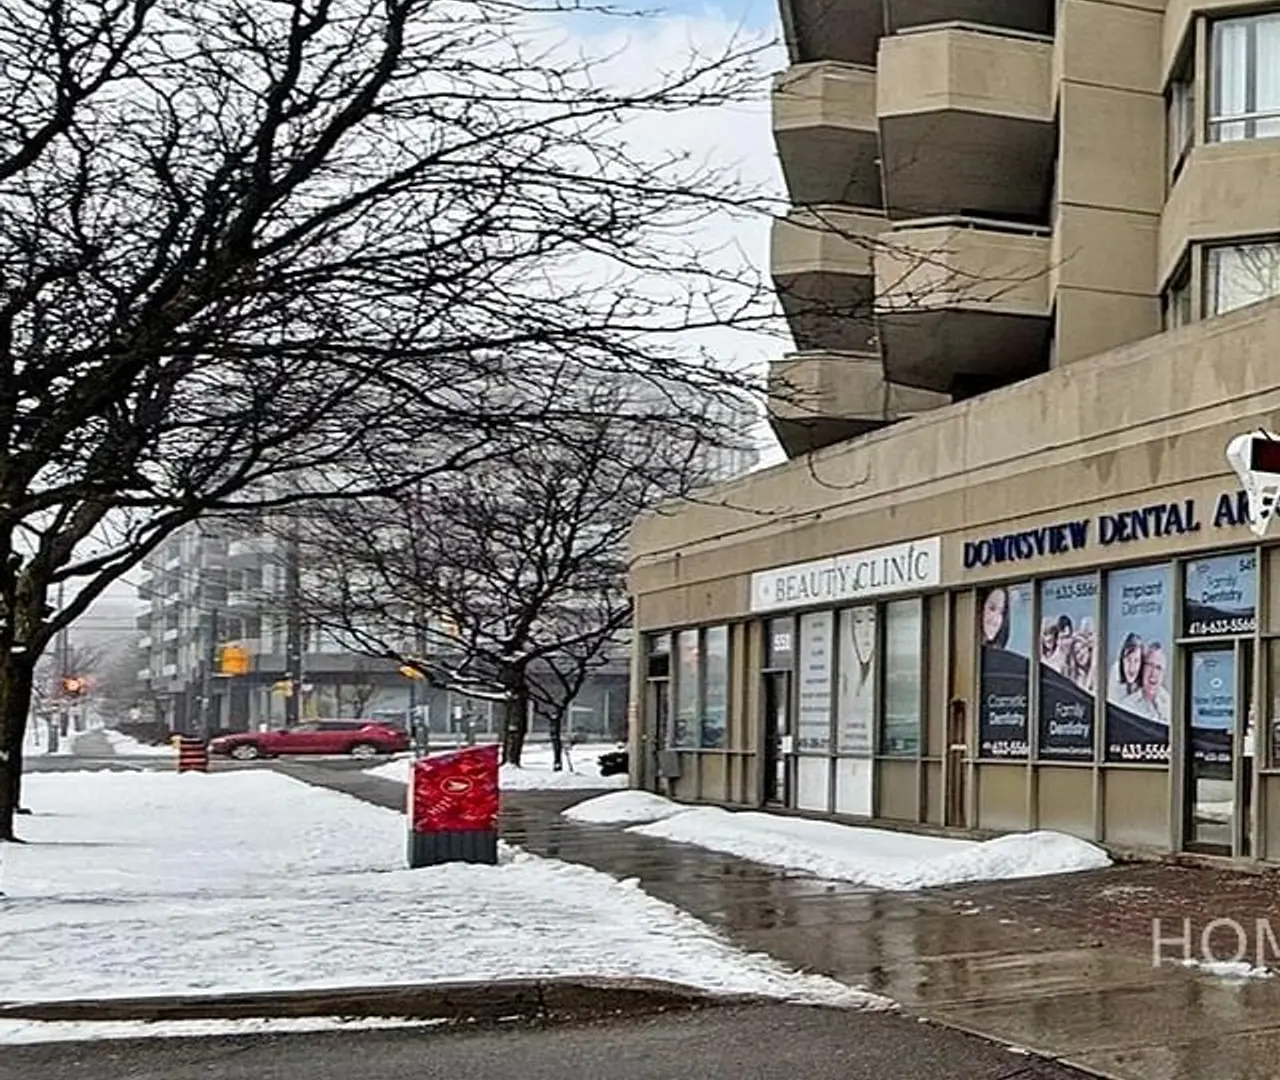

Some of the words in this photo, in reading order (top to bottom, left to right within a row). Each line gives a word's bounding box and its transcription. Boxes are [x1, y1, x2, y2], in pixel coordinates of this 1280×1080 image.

[963, 519, 1090, 568] DOWNSVIEW
[1098, 500, 1200, 545] DENTAL
[775, 566, 849, 602] BEAUTY
[1122, 580, 1163, 599] Implant
